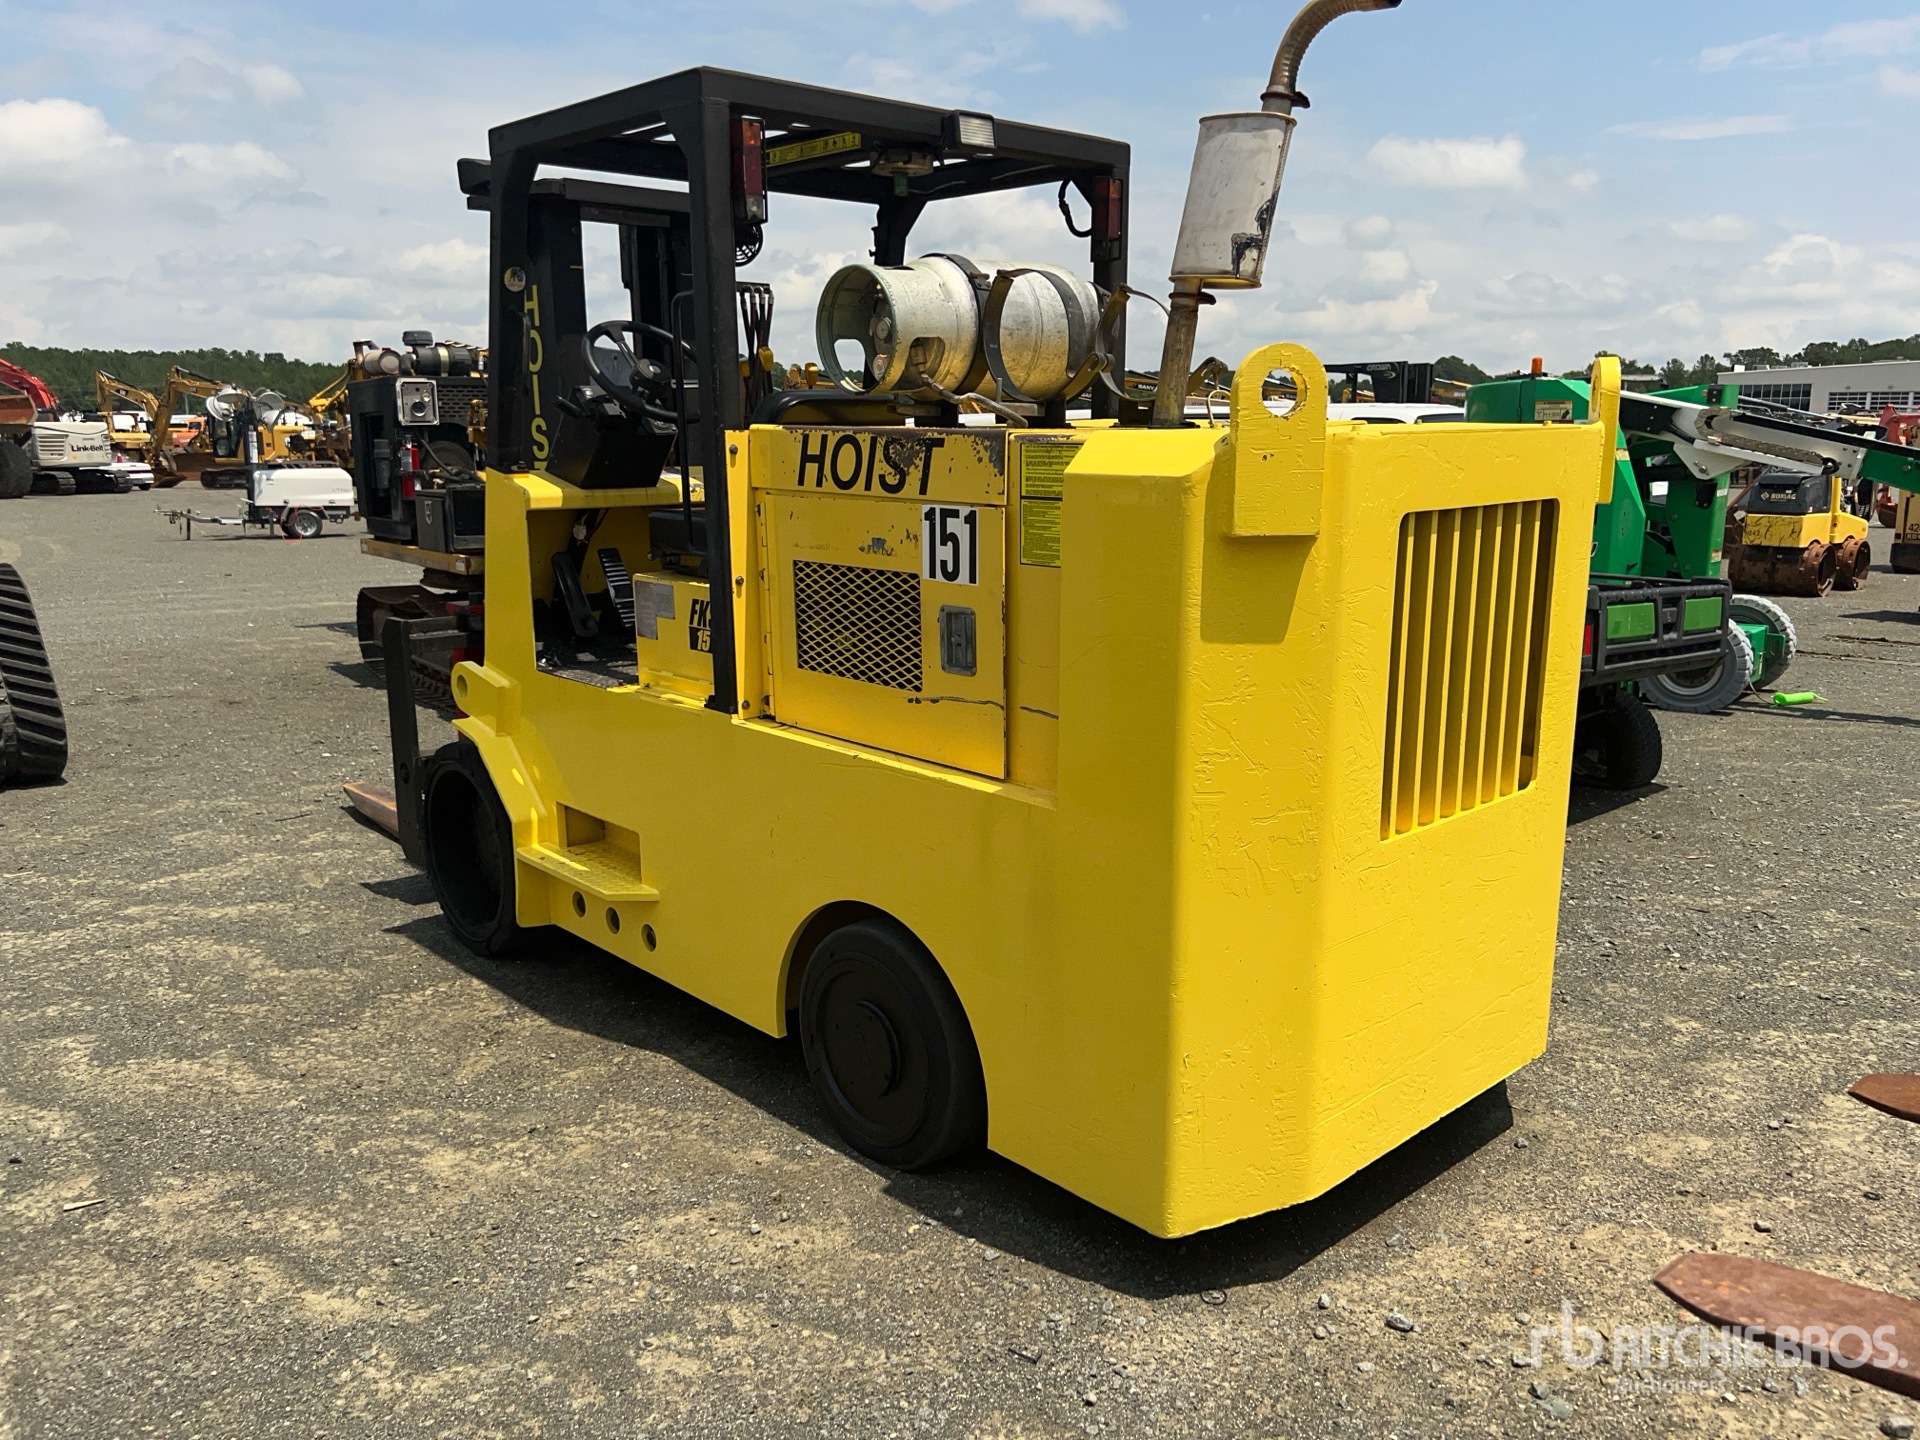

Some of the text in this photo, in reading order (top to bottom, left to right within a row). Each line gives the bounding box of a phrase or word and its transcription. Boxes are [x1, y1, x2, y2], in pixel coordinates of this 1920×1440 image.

[524, 285, 549, 471] HOIS
[798, 434, 945, 495] HOIST
[924, 507, 977, 584] 151
[1908, 523, 1920, 532] 42
[690, 599, 712, 629] FK
